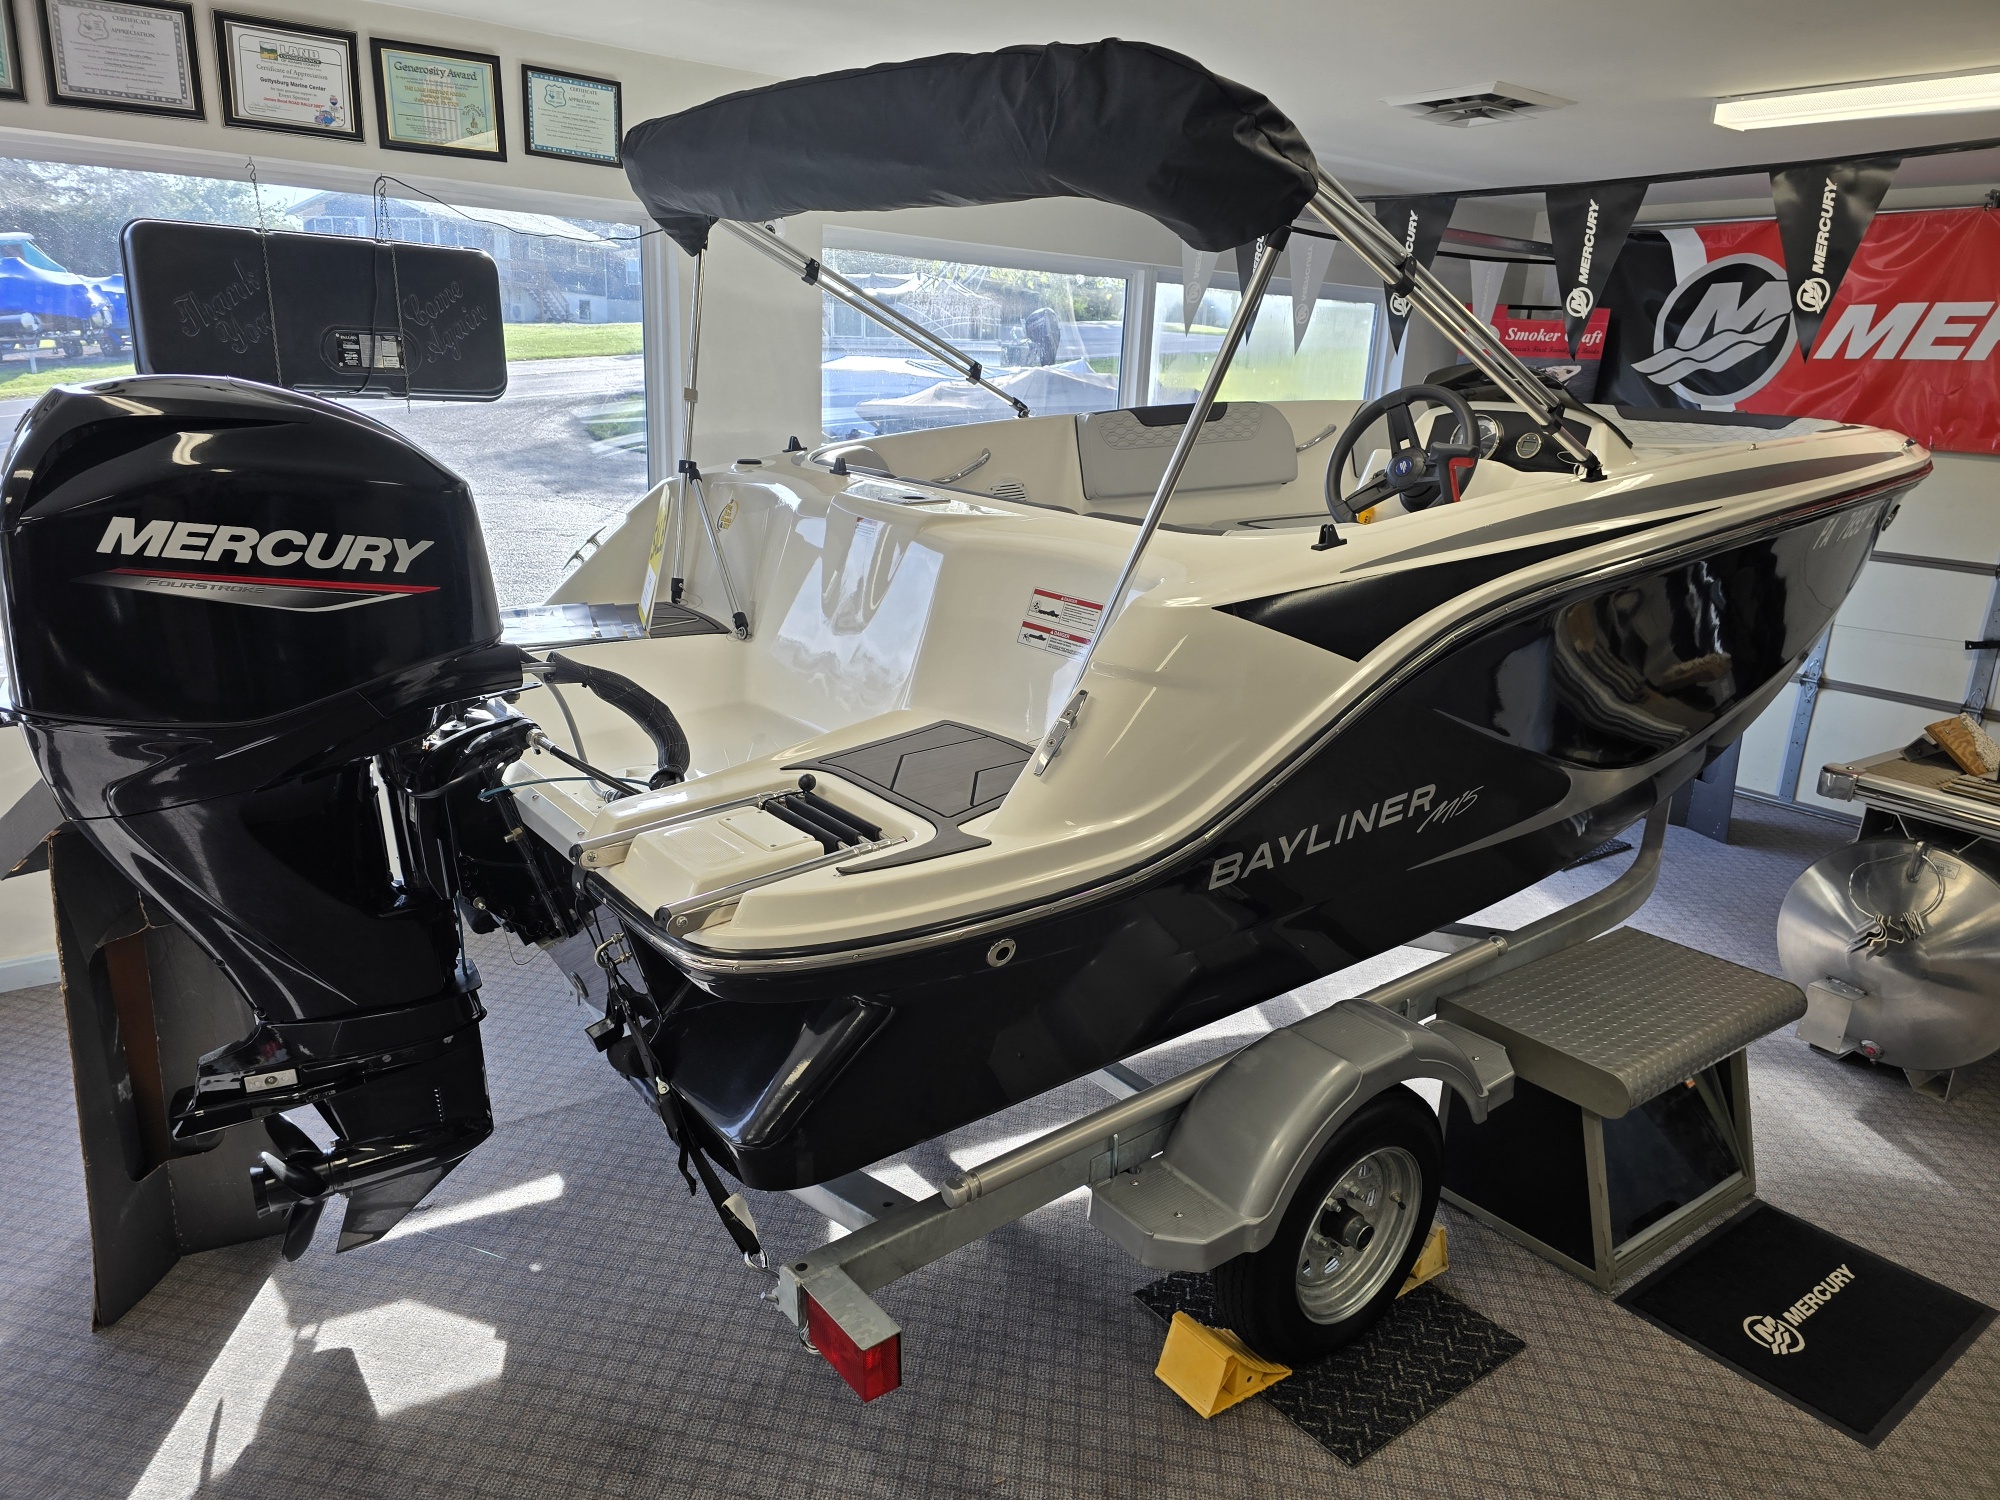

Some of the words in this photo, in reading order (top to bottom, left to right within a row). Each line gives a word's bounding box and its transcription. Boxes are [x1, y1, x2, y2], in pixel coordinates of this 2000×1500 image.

[112, 15, 151, 26] CERTIFICATE
[111, 28, 155, 39] APPRECIATION
[279, 44, 320, 59] LAND
[256, 64, 285, 74] Certificate
[293, 70, 328, 80] Appreciation
[394, 61, 446, 79] Generosity
[447, 69, 477, 80] Award
[260, 77, 289, 87] Gettysburg
[290, 81, 308, 89] Marine
[309, 84, 326, 92] Center
[570, 86, 597, 96] CERTIFICATE
[568, 97, 600, 106] APPRECIATION
[1405, 209, 1418, 257] CURY
[1812, 177, 1837, 274] MERCURY
[1578, 199, 1599, 284] MERCURY
[173, 257, 261, 337] Thank
[402, 279, 464, 327] Come
[425, 303, 488, 364] Again
[1505, 327, 1561, 342] Smoker
[1812, 516, 1841, 551] PA
[96, 516, 435, 573] MERCURY
[1063, 596, 1078, 604] DANGER
[1053, 630, 1070, 639] DANGER
[1208, 784, 1437, 891] BAYLINER
[1782, 1264, 1855, 1327] MERCURY
